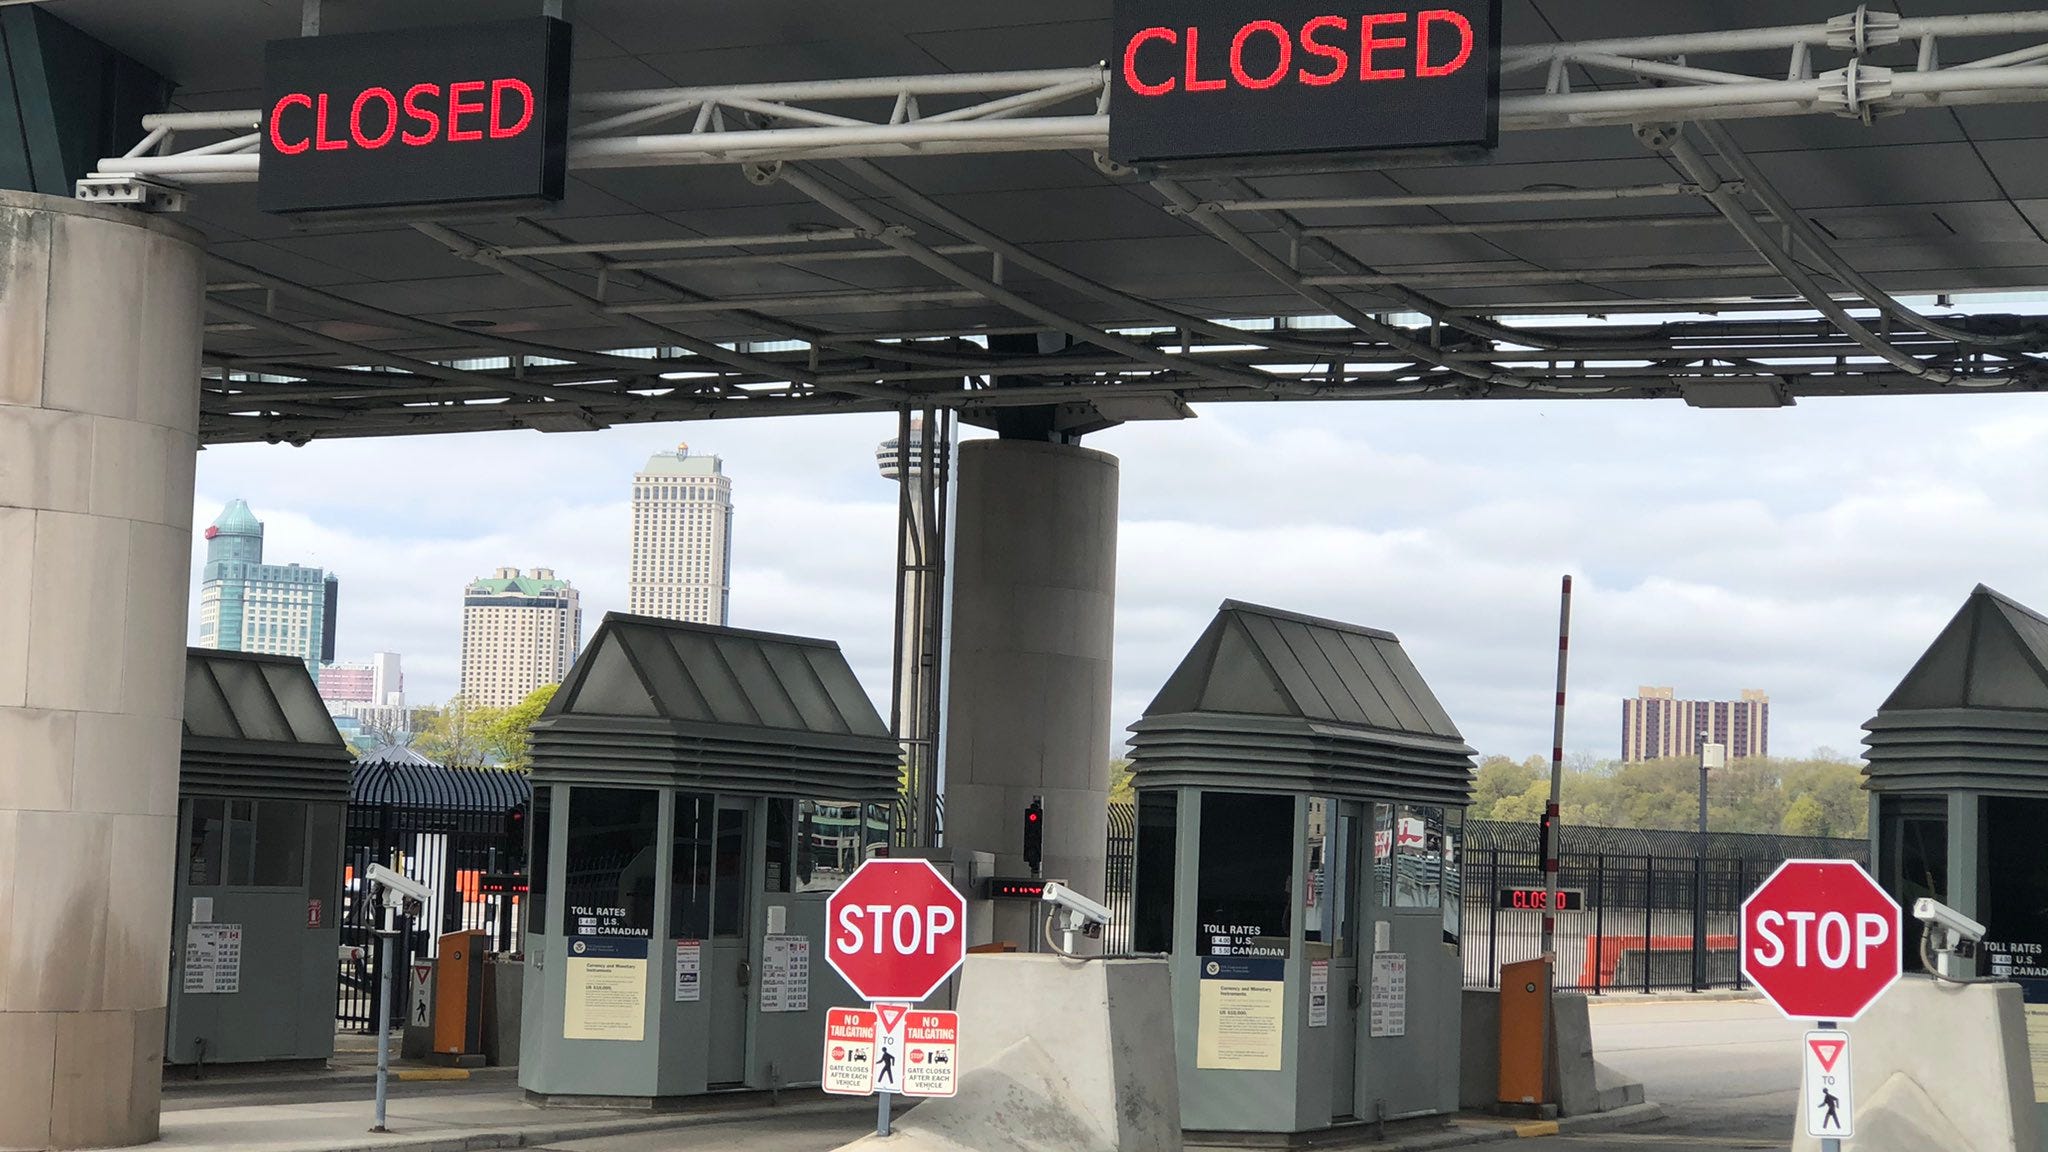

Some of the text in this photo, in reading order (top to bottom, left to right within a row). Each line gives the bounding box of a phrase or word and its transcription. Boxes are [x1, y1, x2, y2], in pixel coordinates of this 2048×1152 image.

[1123, 9, 1474, 96] CLOSED
[270, 78, 534, 155] CLOSED
[1513, 891, 1567, 910] CLOSD
[571, 906, 626, 917] TOLL RATES
[603, 917, 620, 926] U.S.
[597, 927, 649, 936] CANADIAN
[836, 904, 955, 955] STOP
[1203, 924, 1261, 935] TOLL RATES
[1235, 937, 1255, 945] U.S.
[1753, 910, 1889, 969] STOP
[1231, 947, 1285, 956] CANADIAN
[1983, 942, 2041, 953] TOLL RATES
[2016, 955, 2036, 964] U.S.
[844, 1014, 860, 1025] NO
[922, 1016, 939, 1027] NO
[830, 1025, 874, 1038] TAILGATING
[907, 1027, 955, 1040] TAILGATING
[883, 1036, 894, 1046] TO
[835, 1079, 861, 1087] VEHICLE
[1821, 1075, 1836, 1086] TO
